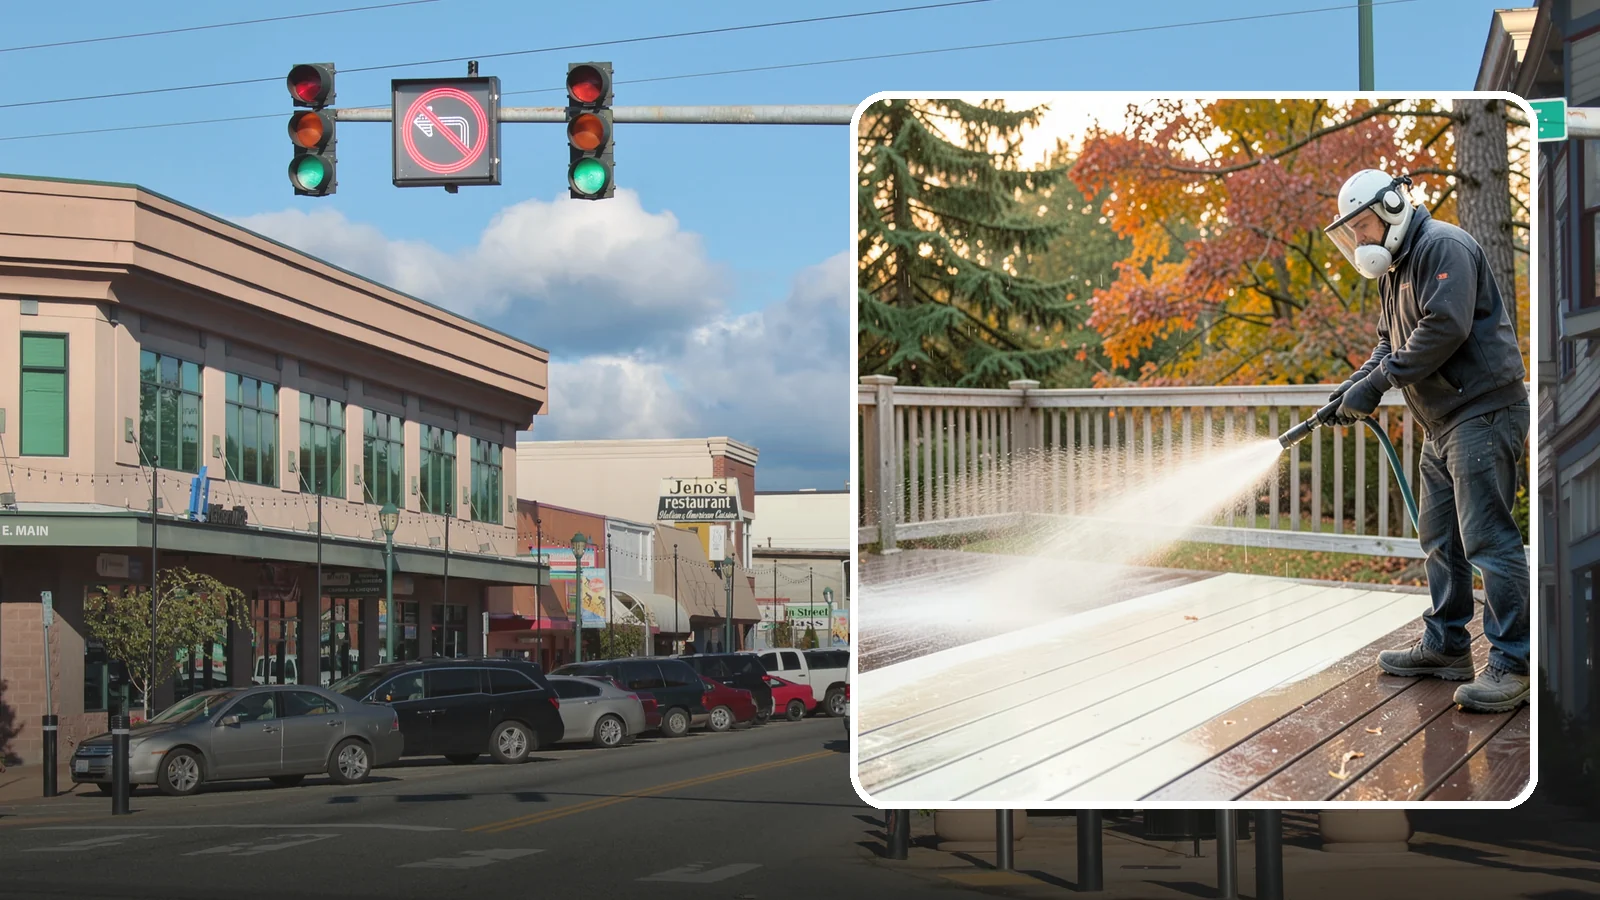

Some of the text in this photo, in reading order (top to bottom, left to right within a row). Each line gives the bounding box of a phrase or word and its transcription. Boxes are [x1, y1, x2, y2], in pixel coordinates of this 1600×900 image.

[669, 480, 728, 495] Jeno's
[665, 496, 731, 509] restaurant
[658, 509, 681, 520] Italian
[686, 509, 715, 520] American
[715, 509, 737, 519] Cuisine
[2, 525, 49, 536] E. MAIN
[797, 607, 829, 617] Street
